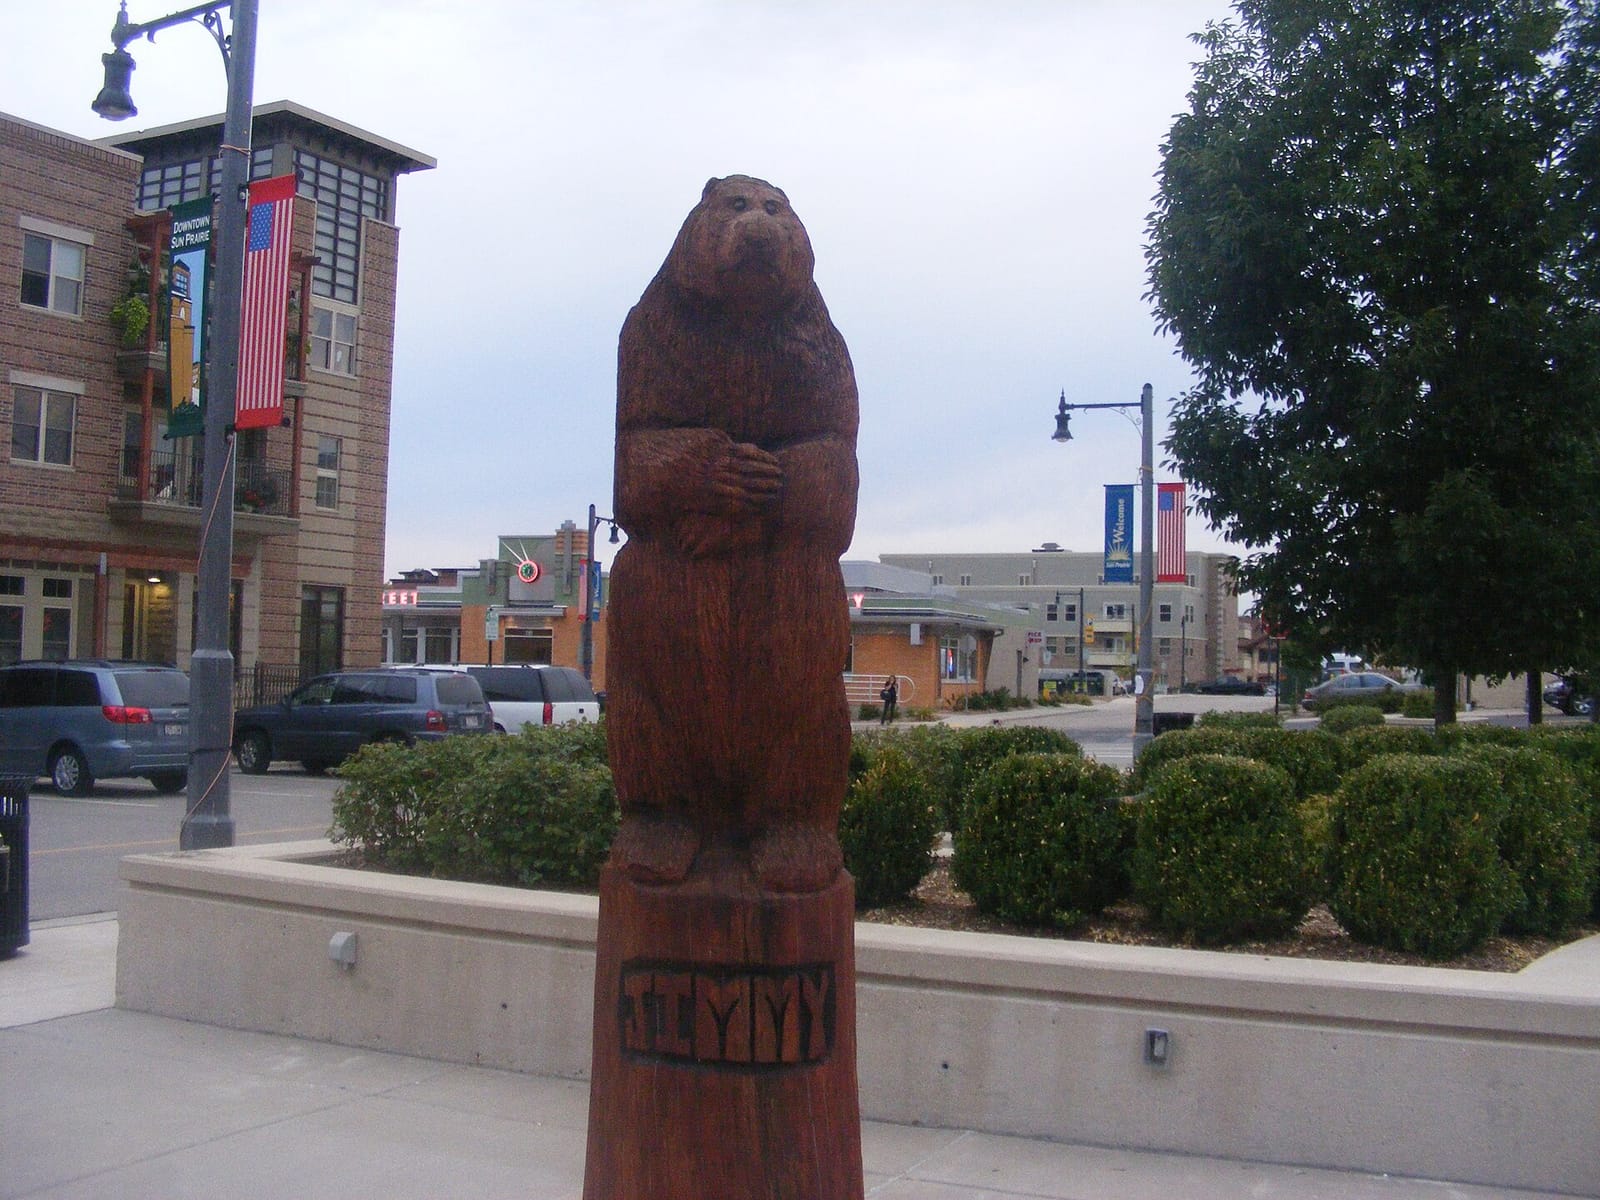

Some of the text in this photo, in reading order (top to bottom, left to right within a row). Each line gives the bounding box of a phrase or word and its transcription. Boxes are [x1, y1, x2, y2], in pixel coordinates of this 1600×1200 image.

[173, 216, 210, 234] DOWNTOWN
[171, 230, 210, 249] SUN PRAIRIE
[1112, 498, 1125, 544] Welcome
[382, 591, 418, 605] EET
[624, 973, 828, 1063] JIMMY
